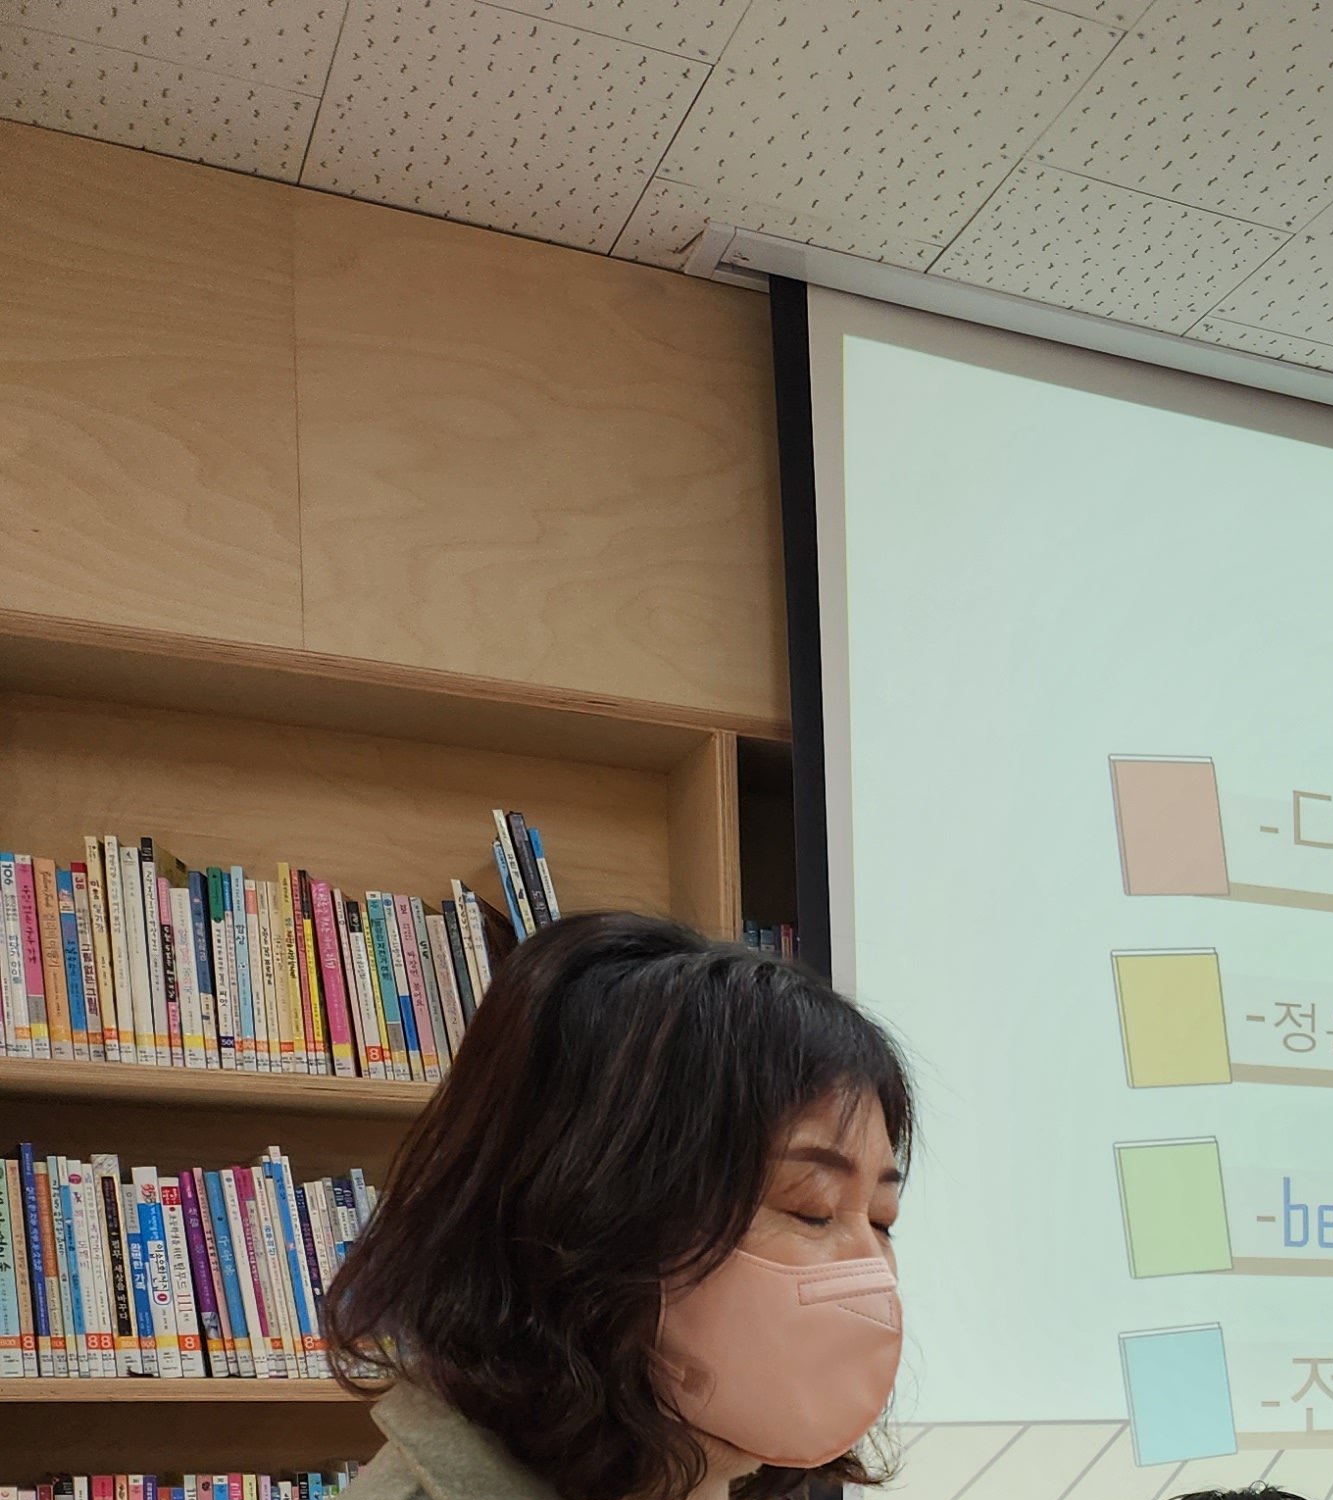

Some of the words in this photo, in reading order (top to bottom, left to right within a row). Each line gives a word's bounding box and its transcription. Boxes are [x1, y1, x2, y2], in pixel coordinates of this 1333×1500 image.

[371, 1048, 380, 1060] 8
[23, 1336, 34, 1349] 8
[88, 1336, 98, 1349] 8
[101, 1336, 111, 1349] 8
[184, 1337, 194, 1349] 8
[304, 1336, 314, 1349] 8
